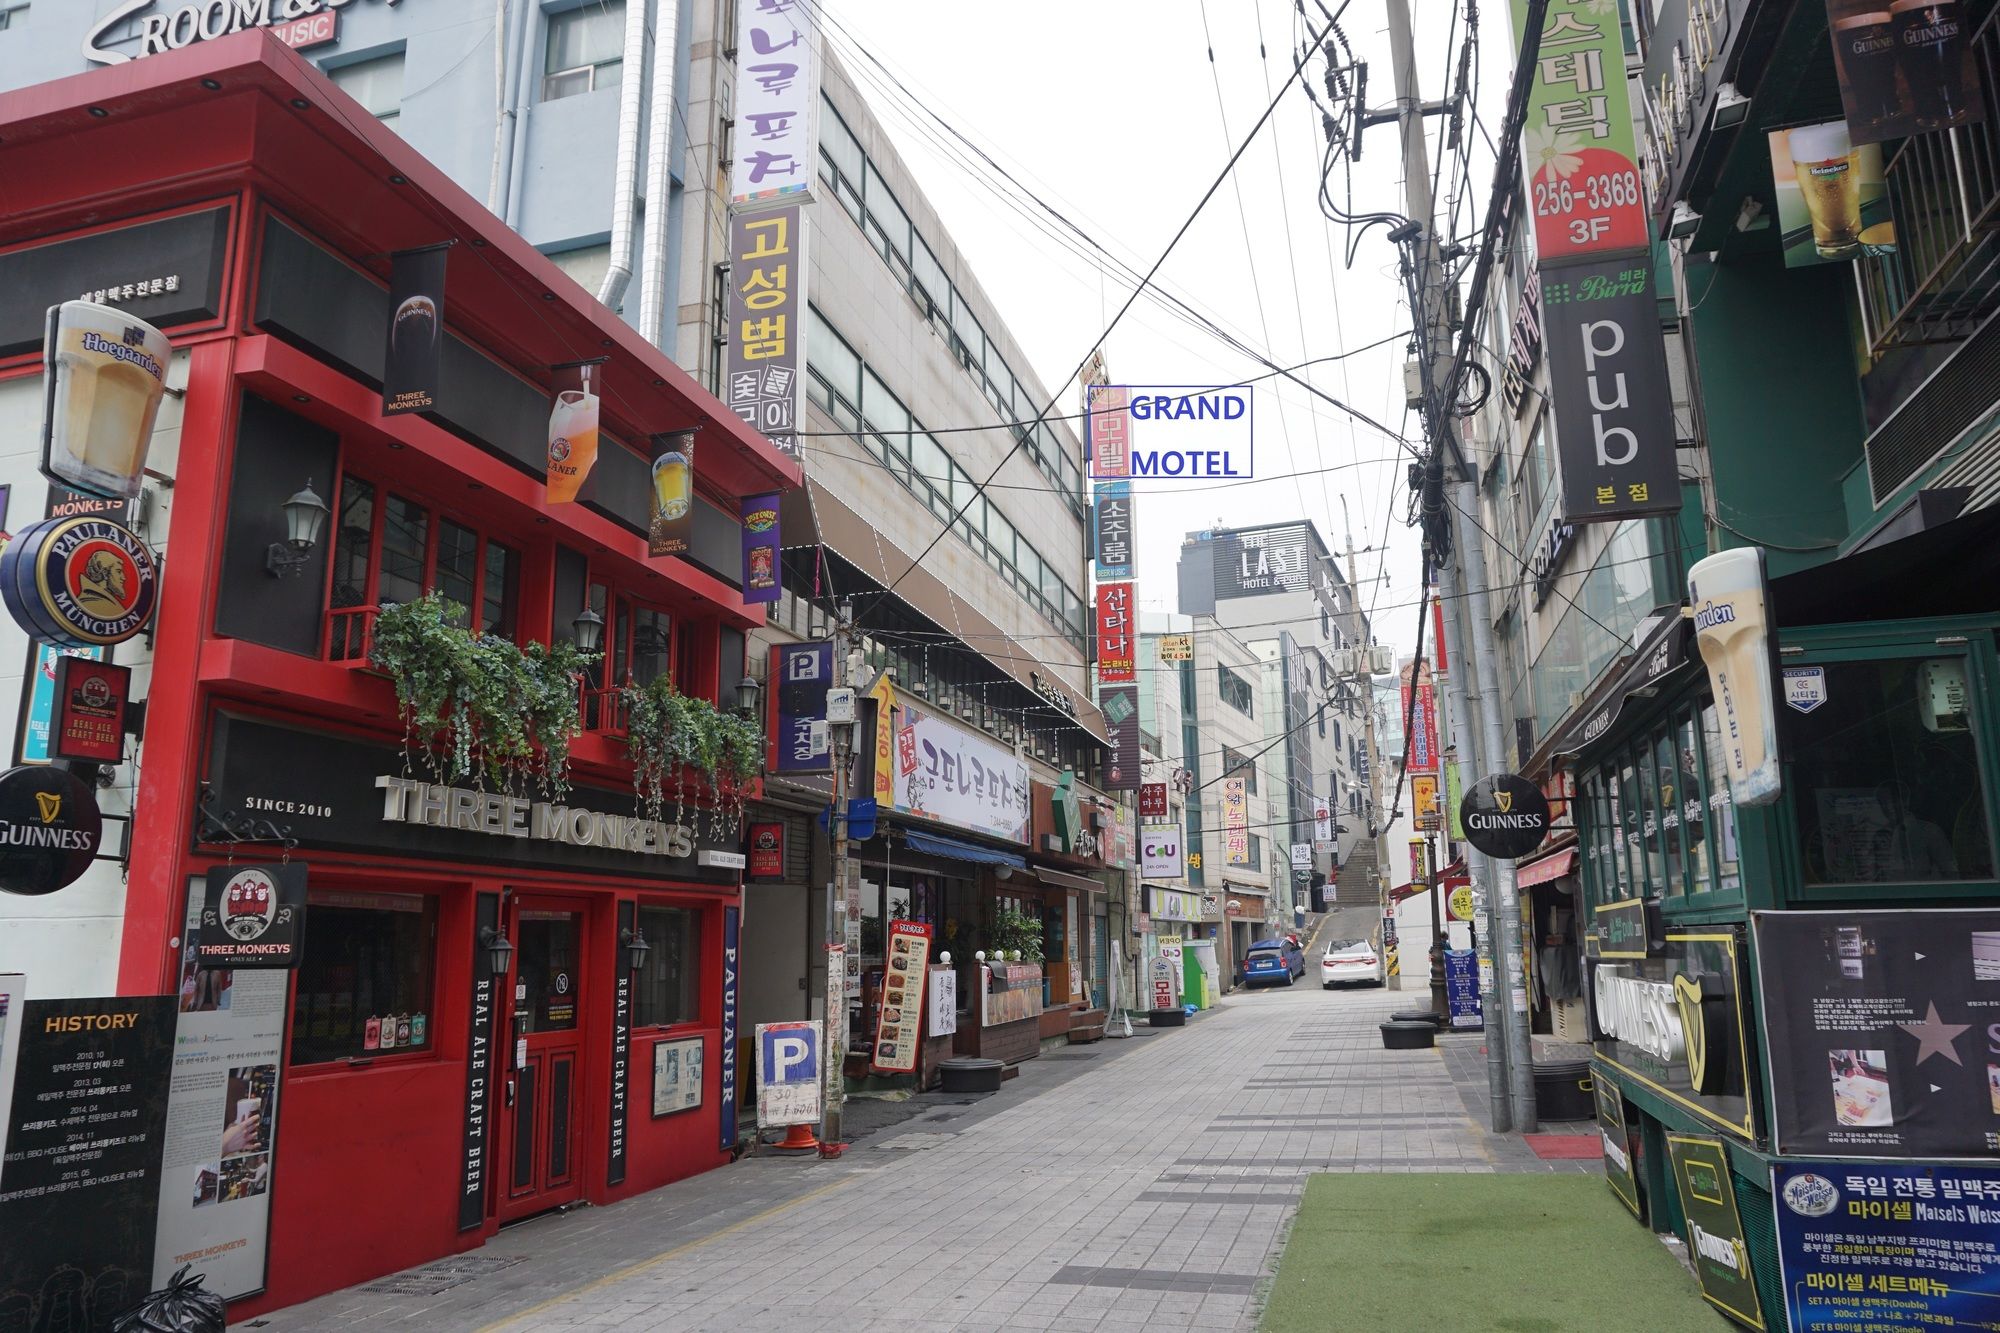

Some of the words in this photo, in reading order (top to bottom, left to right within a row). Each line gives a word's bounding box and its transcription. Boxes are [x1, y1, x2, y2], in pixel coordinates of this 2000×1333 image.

[1903, 22, 1959, 48] GUINNESS
[1538, 0, 1610, 140] 스테틱
[1809, 163, 1849, 177] Heineken
[1536, 170, 1638, 216] 256-3368
[1569, 217, 1611, 244] 3F
[1619, 267, 1647, 282] 비라
[741, 216, 789, 361] 고성범
[1576, 276, 1647, 303] Birra
[82, 331, 163, 382] Hoegaarden
[396, 391, 425, 402] THREE
[734, 369, 789, 400] 숯불
[1580, 319, 1639, 467] pub
[388, 400, 432, 411] MONKEYS
[1097, 417, 1124, 468] 모텔
[1595, 482, 1649, 504] 본점
[52, 498, 124, 518] MONKEYS
[51, 521, 153, 583] PAULANER
[1241, 546, 1304, 577] LAST
[1243, 579, 1270, 589] HOTEL
[53, 591, 141, 636] MÜNCHEN
[1104, 588, 1128, 657] 산타나
[1695, 601, 1736, 632] arden
[1180, 635, 1189, 645] kt
[794, 654, 813, 678] P
[1102, 659, 1133, 674] 노래방
[1785, 670, 1818, 678] SECURITY
[1791, 690, 1818, 699] 시티캅
[67, 729, 93, 739] CRAFT
[96, 733, 115, 743] BEER
[97, 723, 112, 733] ALE
[1142, 785, 1163, 797] 사주
[1226, 781, 1242, 806] 여왕
[246, 797, 295, 813] SINCE
[298, 803, 332, 818] 2010
[376, 775, 531, 839] THREE
[531, 801, 693, 858] MONKEYS
[1228, 808, 1246, 854] 노래방
[1468, 813, 1542, 829] GUINNESS
[0, 820, 92, 851] GUINNESS
[1145, 844, 1176, 857] CU
[200, 945, 235, 955] THREE
[236, 944, 291, 954] MONKEYS
[475, 979, 489, 1027] REAL
[618, 978, 628, 1017] REAL
[45, 1013, 138, 1034] HISTORY
[721, 946, 736, 1106] PAULANER
[473, 1032, 487, 1070] ALE
[616, 1025, 626, 1054] ALE
[97, 1051, 105, 1059] 10
[774, 1037, 809, 1083] P
[614, 1060, 625, 1112] CRAFT
[469, 1078, 484, 1138] CRAFT
[612, 1119, 623, 1159] BEER
[27, 1149, 43, 1159] BBQ
[43, 1145, 67, 1155] HOUSE
[82, 1178, 97, 1186] BBQ
[466, 1147, 481, 1195] BEER
[1845, 1175, 1888, 1197] 독일
[1893, 1177, 1936, 1199] 전통
[1940, 1179, 2000, 1201] 밀맥주
[1848, 1201, 1912, 1220] 마이셀
[1916, 1203, 1966, 1223] Maisel's
[174, 1246, 205, 1264] THREE
[201, 1237, 247, 1259] MONKEYS
[1802, 1243, 1832, 1253] 풍부한
[1834, 1244, 1873, 1255] 과일향이
[1875, 1246, 1914, 1256] 특징이며
[1804, 1232, 1843, 1243] 마이셀은
[1846, 1234, 1865, 1244] 독일
[1867, 1235, 1906, 1246] 남부지방
[1908, 1237, 1951, 1250] 프리미엄
[1953, 1240, 1996, 1253] 밀맥주로
[1820, 1254, 1849, 1264] 진정한
[1851, 1255, 1891, 1266] 밀맥주로
[1893, 1256, 1912, 1268] 각광
[1915, 1258, 1937, 1268] 받고
[1938, 1260, 1986, 1274] 있습니다.
[1806, 1272, 1864, 1292] 마이셀
[1868, 1273, 1949, 1298] 세트메뉴
[1808, 1297, 1823, 1305] SET
[1824, 1297, 1831, 1305] A
[1832, 1297, 1860, 1307] 마이셀
[1862, 1298, 1928, 1310] 생맥주(Double)
[1811, 1323, 1826, 1331] SET
[1827, 1323, 1833, 1331] B
[1835, 1323, 1862, 1333] 마이셀
[1833, 1309, 1858, 1318] 500cc
[1860, 1310, 1874, 1319] 2잔
[1884, 1310, 1903, 1320] 나초
[1913, 1312, 1954, 1326] 기본과일
